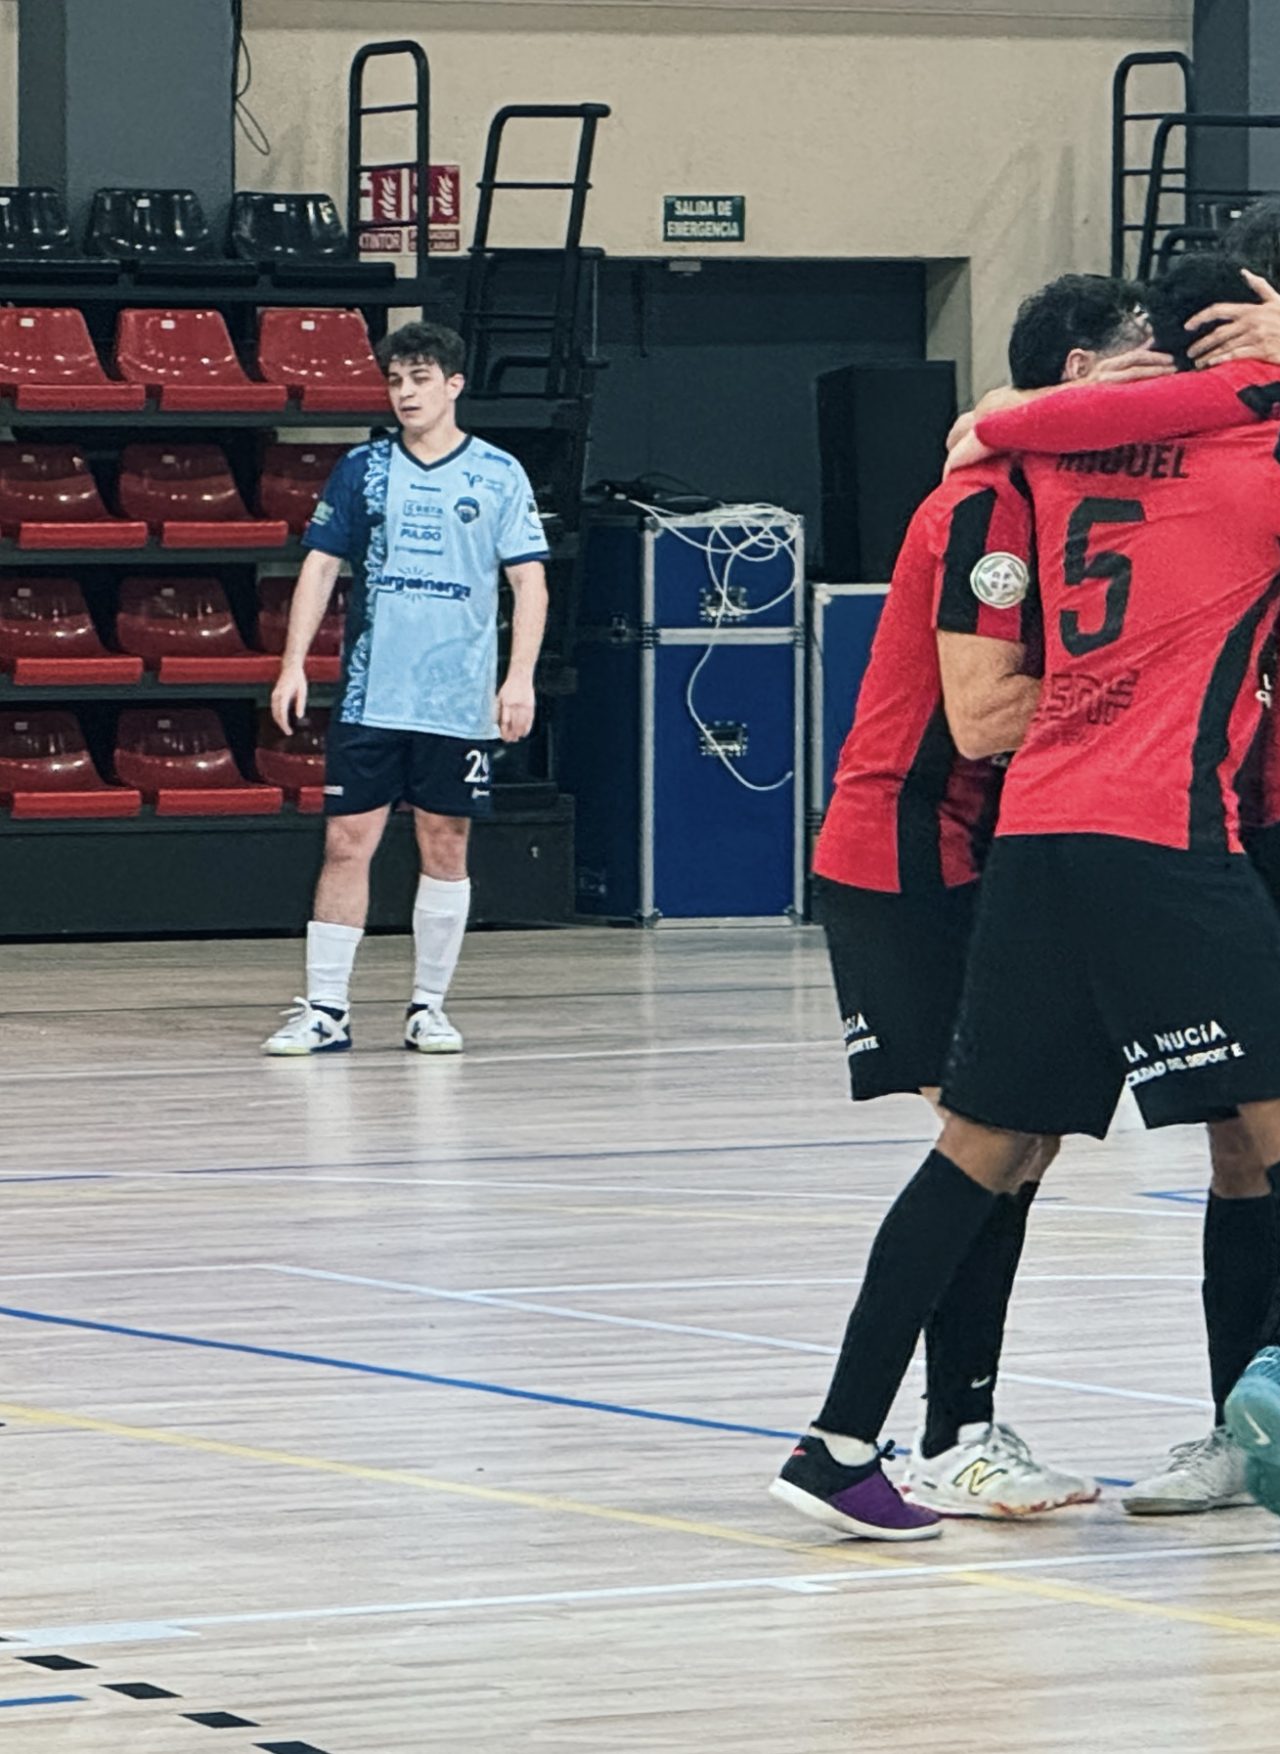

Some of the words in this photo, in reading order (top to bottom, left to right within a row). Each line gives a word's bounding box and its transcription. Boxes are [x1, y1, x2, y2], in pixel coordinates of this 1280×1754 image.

[674, 200, 715, 216] SALIDA
[717, 200, 733, 216] DE
[667, 221, 740, 238] EMERGENCIA
[1060, 497, 1146, 657] 5
[1123, 1041, 1149, 1064] LA
